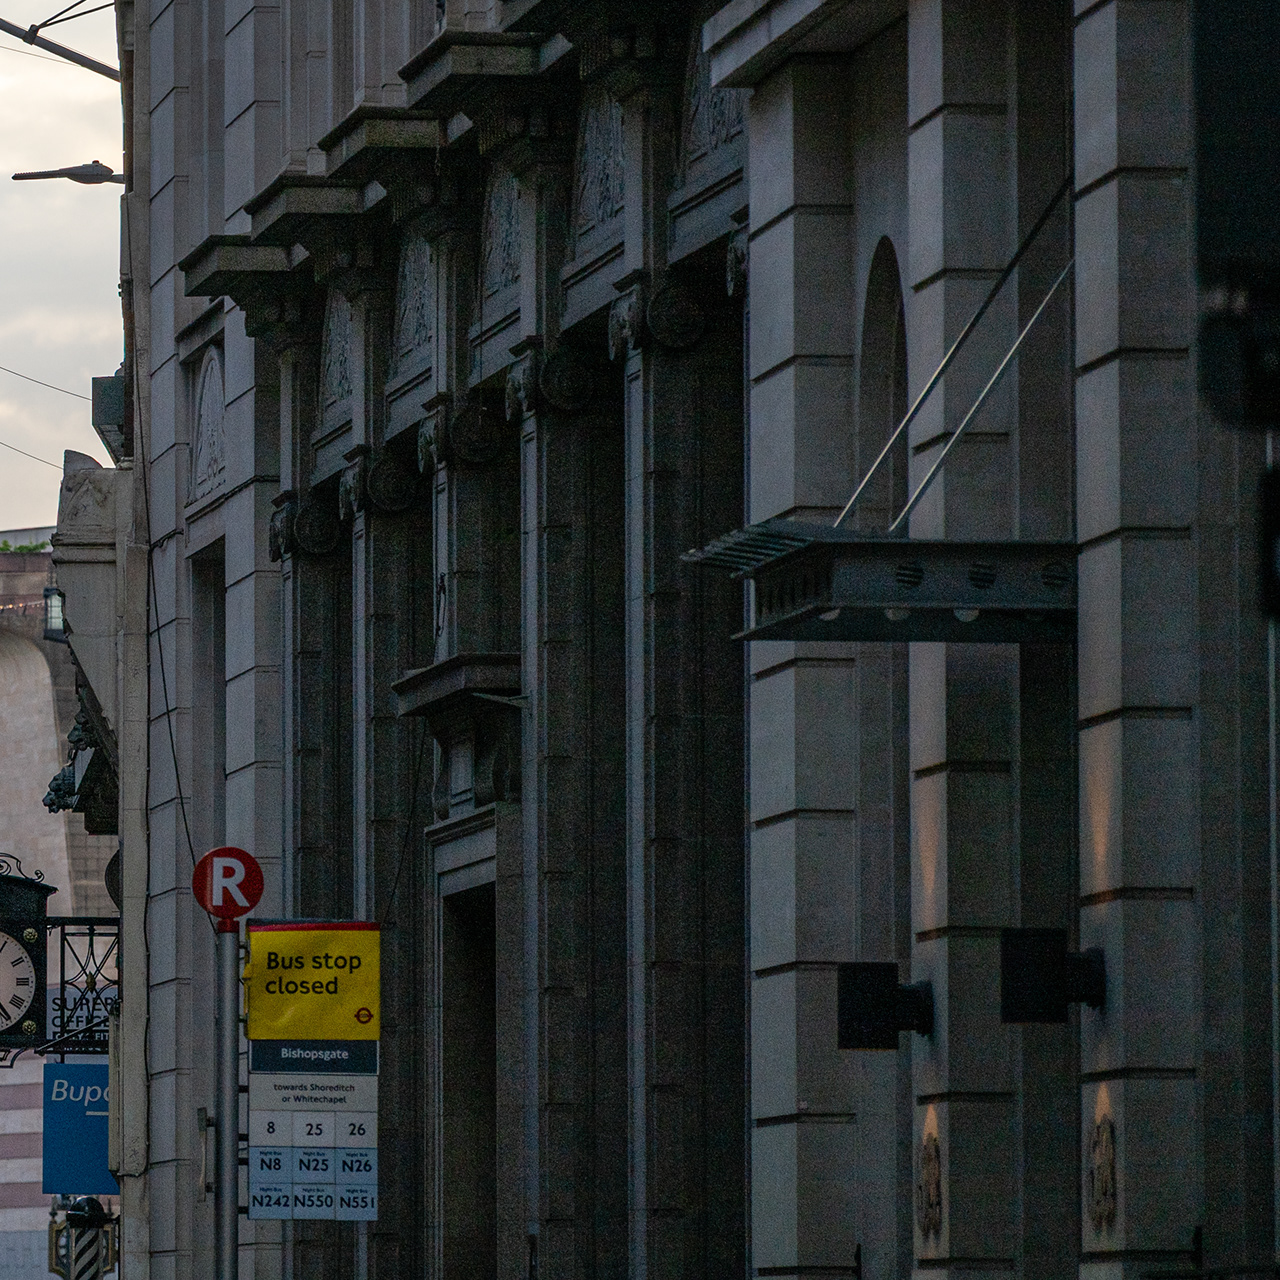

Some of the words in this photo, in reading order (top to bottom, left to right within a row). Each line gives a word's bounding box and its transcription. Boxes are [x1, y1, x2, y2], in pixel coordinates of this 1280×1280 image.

[211, 856, 250, 908] R
[266, 951, 305, 970] Bus
[311, 953, 362, 974] stop
[265, 976, 338, 995] closed
[280, 1047, 349, 1061] Bishopsgate
[273, 1083, 308, 1091] towards
[309, 1083, 355, 1092] Shoreditch
[293, 1095, 347, 1104] Whitechapel
[266, 1121, 275, 1135] 8
[305, 1123, 322, 1136] 25
[348, 1123, 366, 1137] 26
[260, 1157, 281, 1171] N8
[299, 1158, 329, 1171] N25
[342, 1159, 372, 1172] N26
[252, 1194, 290, 1207] N242
[294, 1195, 333, 1207] N550
[340, 1196, 375, 1209] N551
